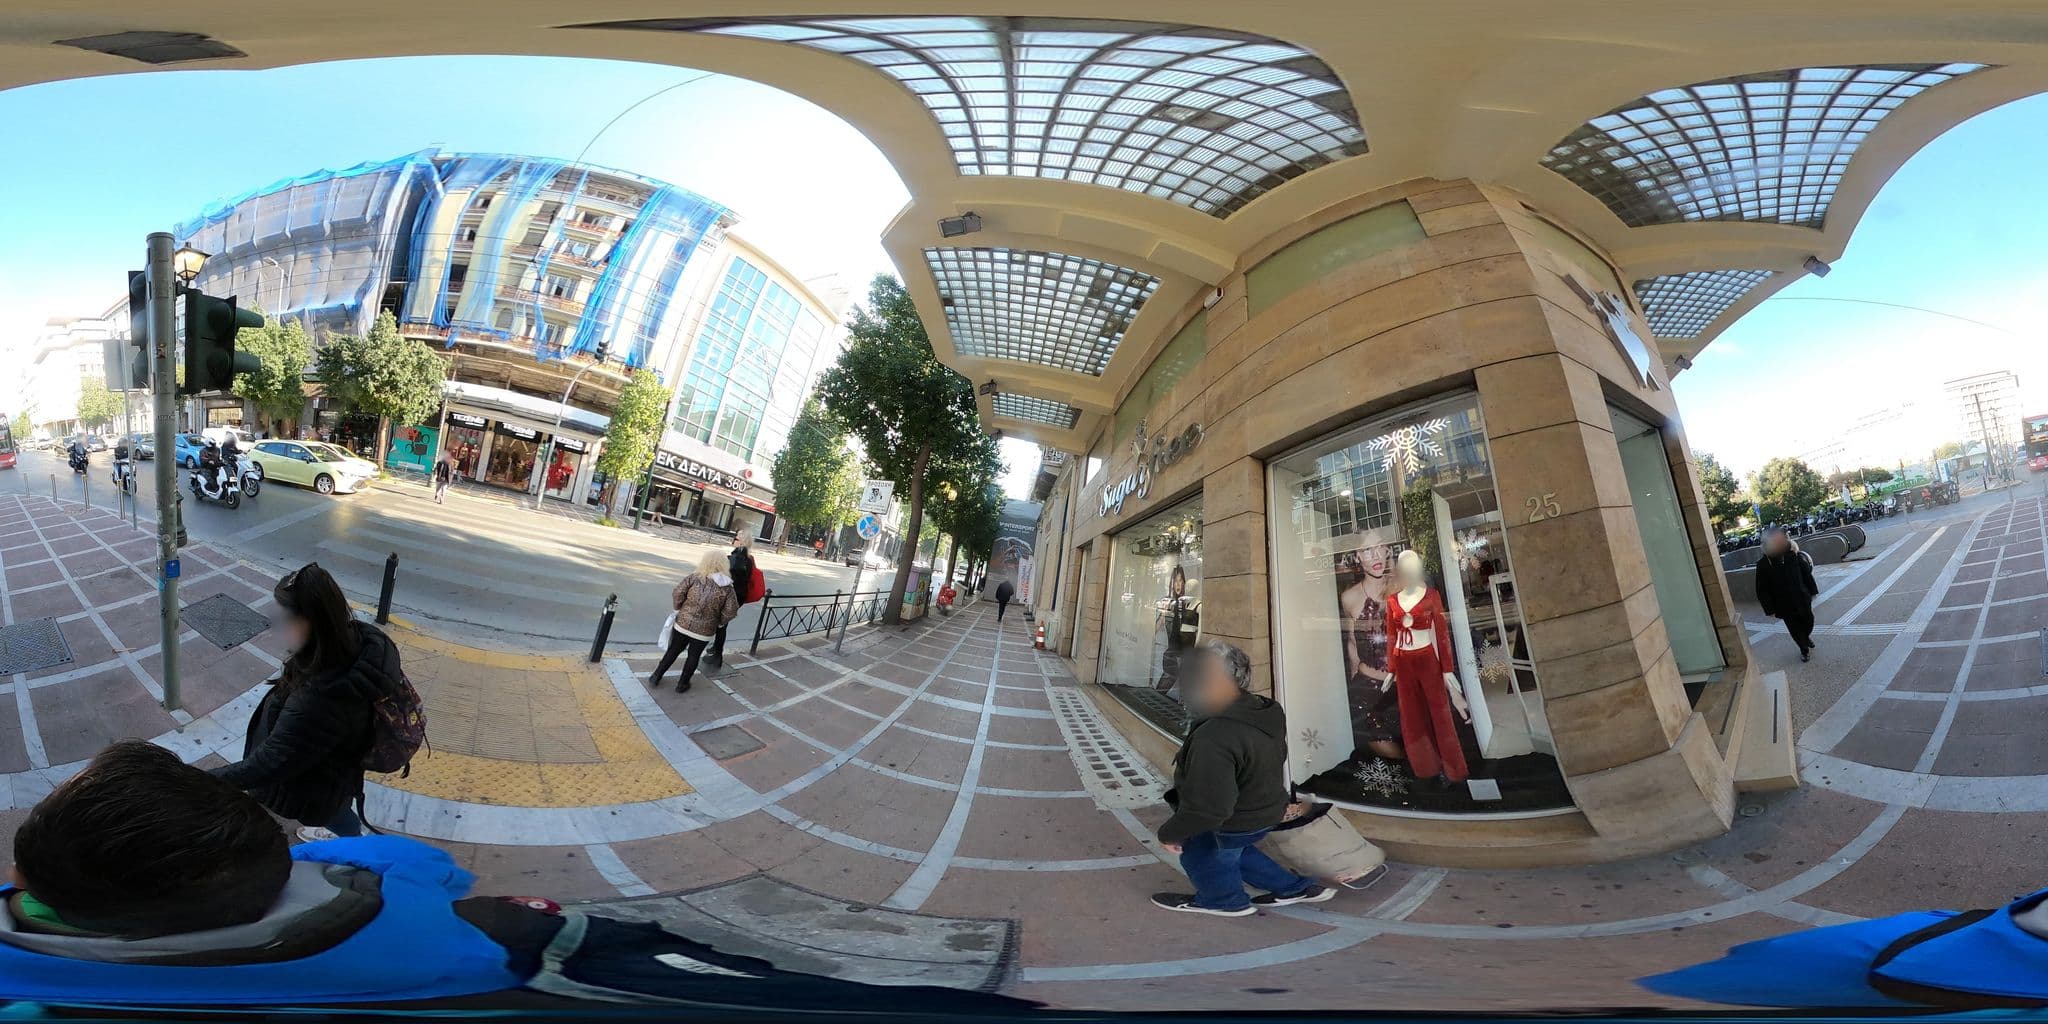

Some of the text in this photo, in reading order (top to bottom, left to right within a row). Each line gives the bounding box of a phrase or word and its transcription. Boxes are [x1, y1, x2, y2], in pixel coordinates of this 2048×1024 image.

[657, 451, 747, 493] ΕΚ ΔΕΛΤΑ 360
[1526, 492, 1562, 523] 25
